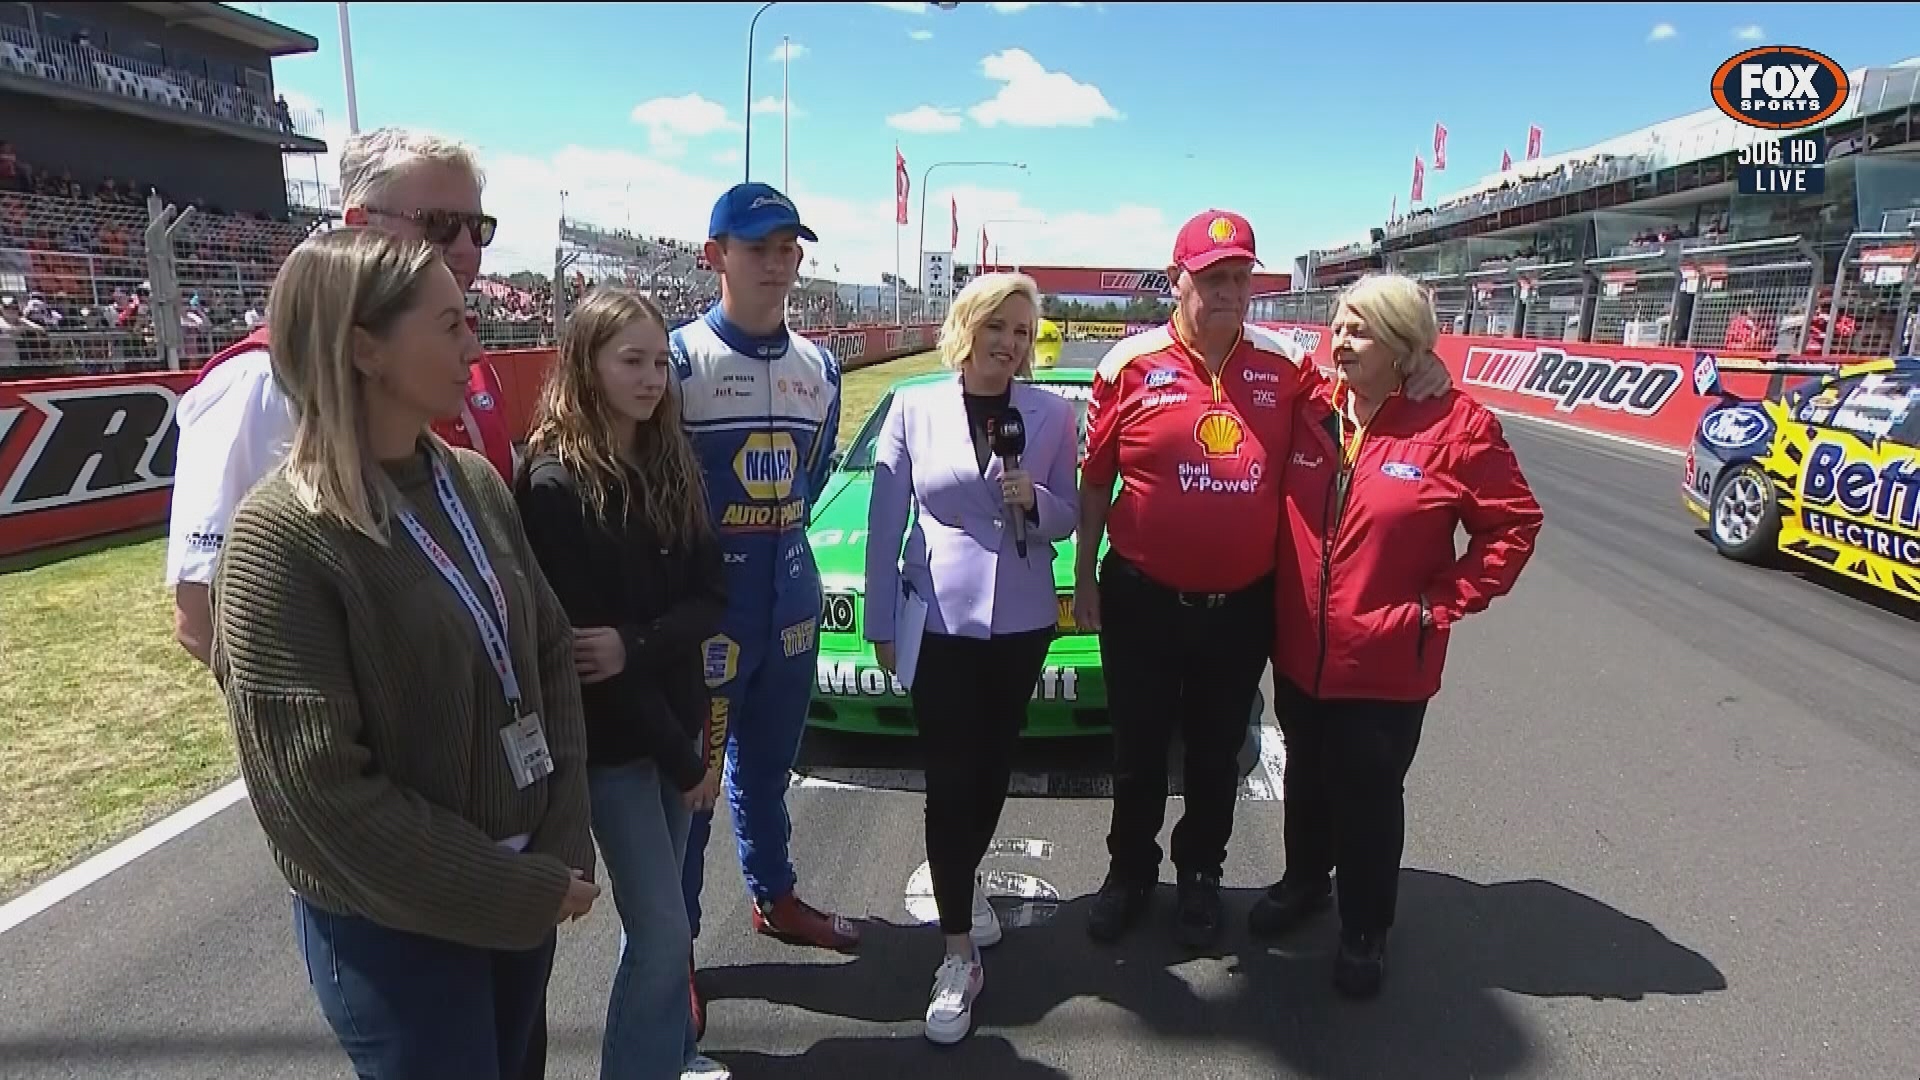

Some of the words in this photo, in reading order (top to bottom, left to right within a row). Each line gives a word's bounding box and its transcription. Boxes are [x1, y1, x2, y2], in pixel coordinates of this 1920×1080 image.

[1520, 349, 1682, 414] Repco
[1178, 462, 1209, 475] Shell
[1179, 477, 1257, 492] V-Power
[721, 503, 771, 525] AUTO
